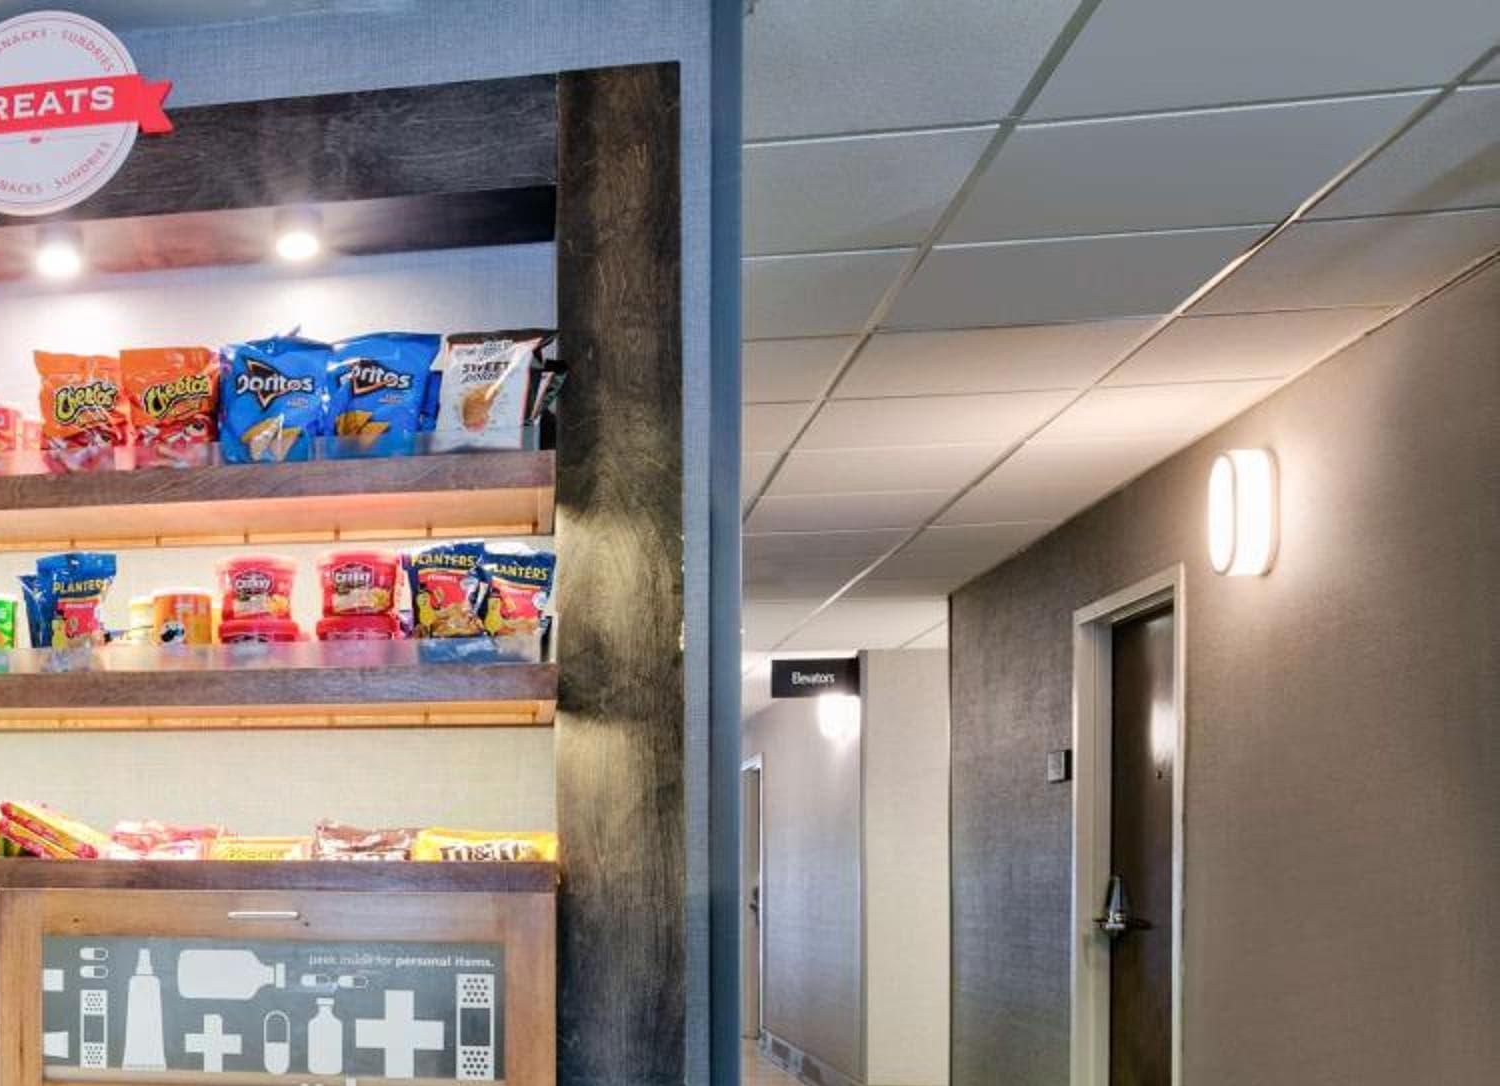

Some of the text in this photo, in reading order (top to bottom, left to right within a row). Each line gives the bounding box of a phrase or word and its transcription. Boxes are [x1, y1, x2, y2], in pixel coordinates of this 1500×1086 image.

[236, 373, 314, 394] Doritos
[56, 381, 117, 421] Cheetos
[144, 375, 211, 418] Cheetos
[791, 671, 835, 686] Elevators
[395, 954, 451, 968] personal
